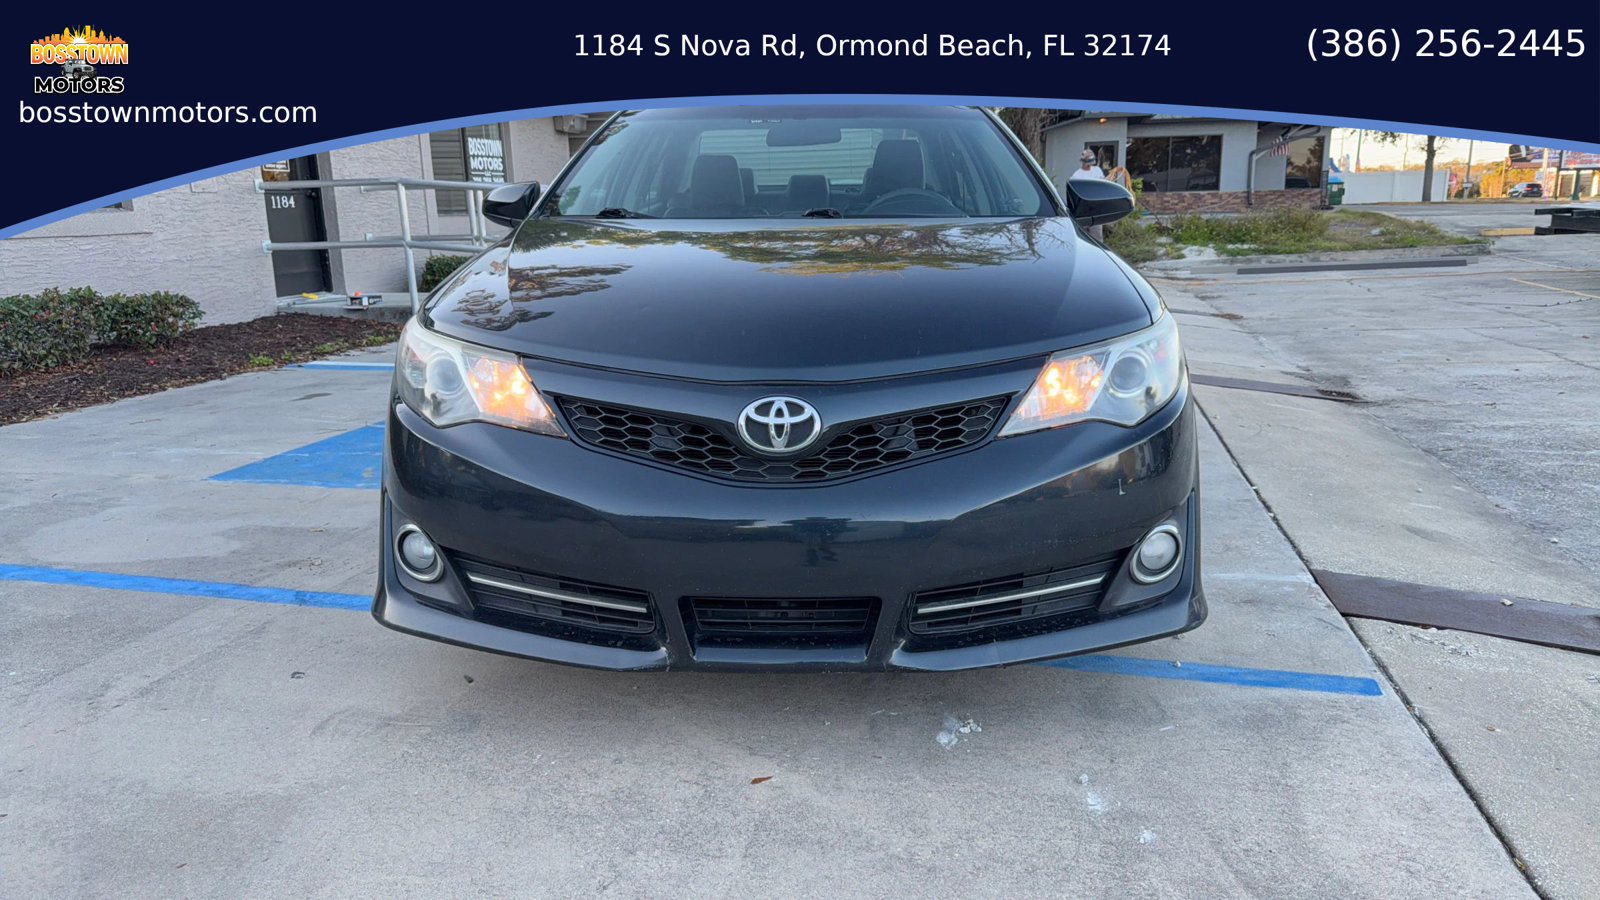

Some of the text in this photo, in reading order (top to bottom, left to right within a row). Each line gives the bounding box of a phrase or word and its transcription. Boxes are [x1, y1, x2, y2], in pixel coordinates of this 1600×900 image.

[468, 137, 502, 157] BOSSTOWN
[470, 156, 504, 171] MOTORS
[271, 195, 296, 209] 1184
